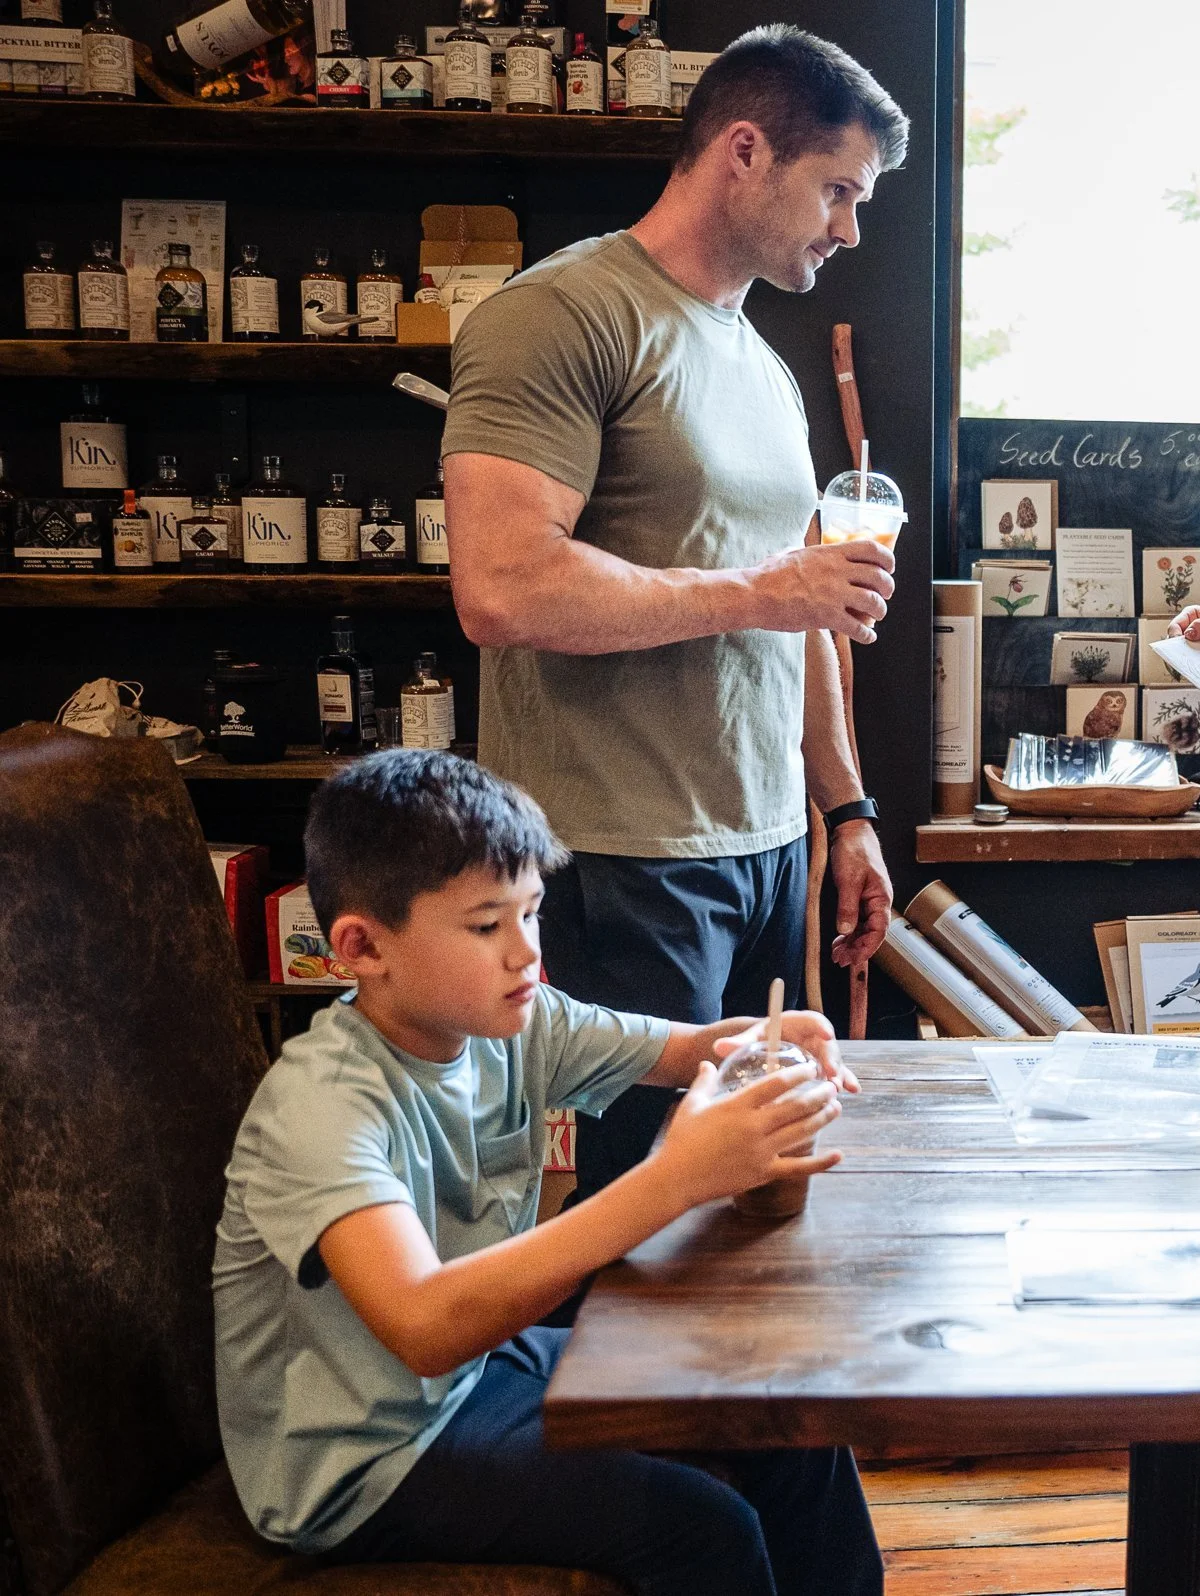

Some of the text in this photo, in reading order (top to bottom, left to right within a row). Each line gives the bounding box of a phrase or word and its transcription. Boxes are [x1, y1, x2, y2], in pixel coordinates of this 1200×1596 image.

[0, 37, 82, 49] OCKTAIL BITTER
[69, 436, 117, 466] Kin
[999, 432, 1063, 467] Seed
[1073, 433, 1142, 469] Cards
[247, 511, 292, 541] Kin
[292, 924, 322, 932] Rainbo
